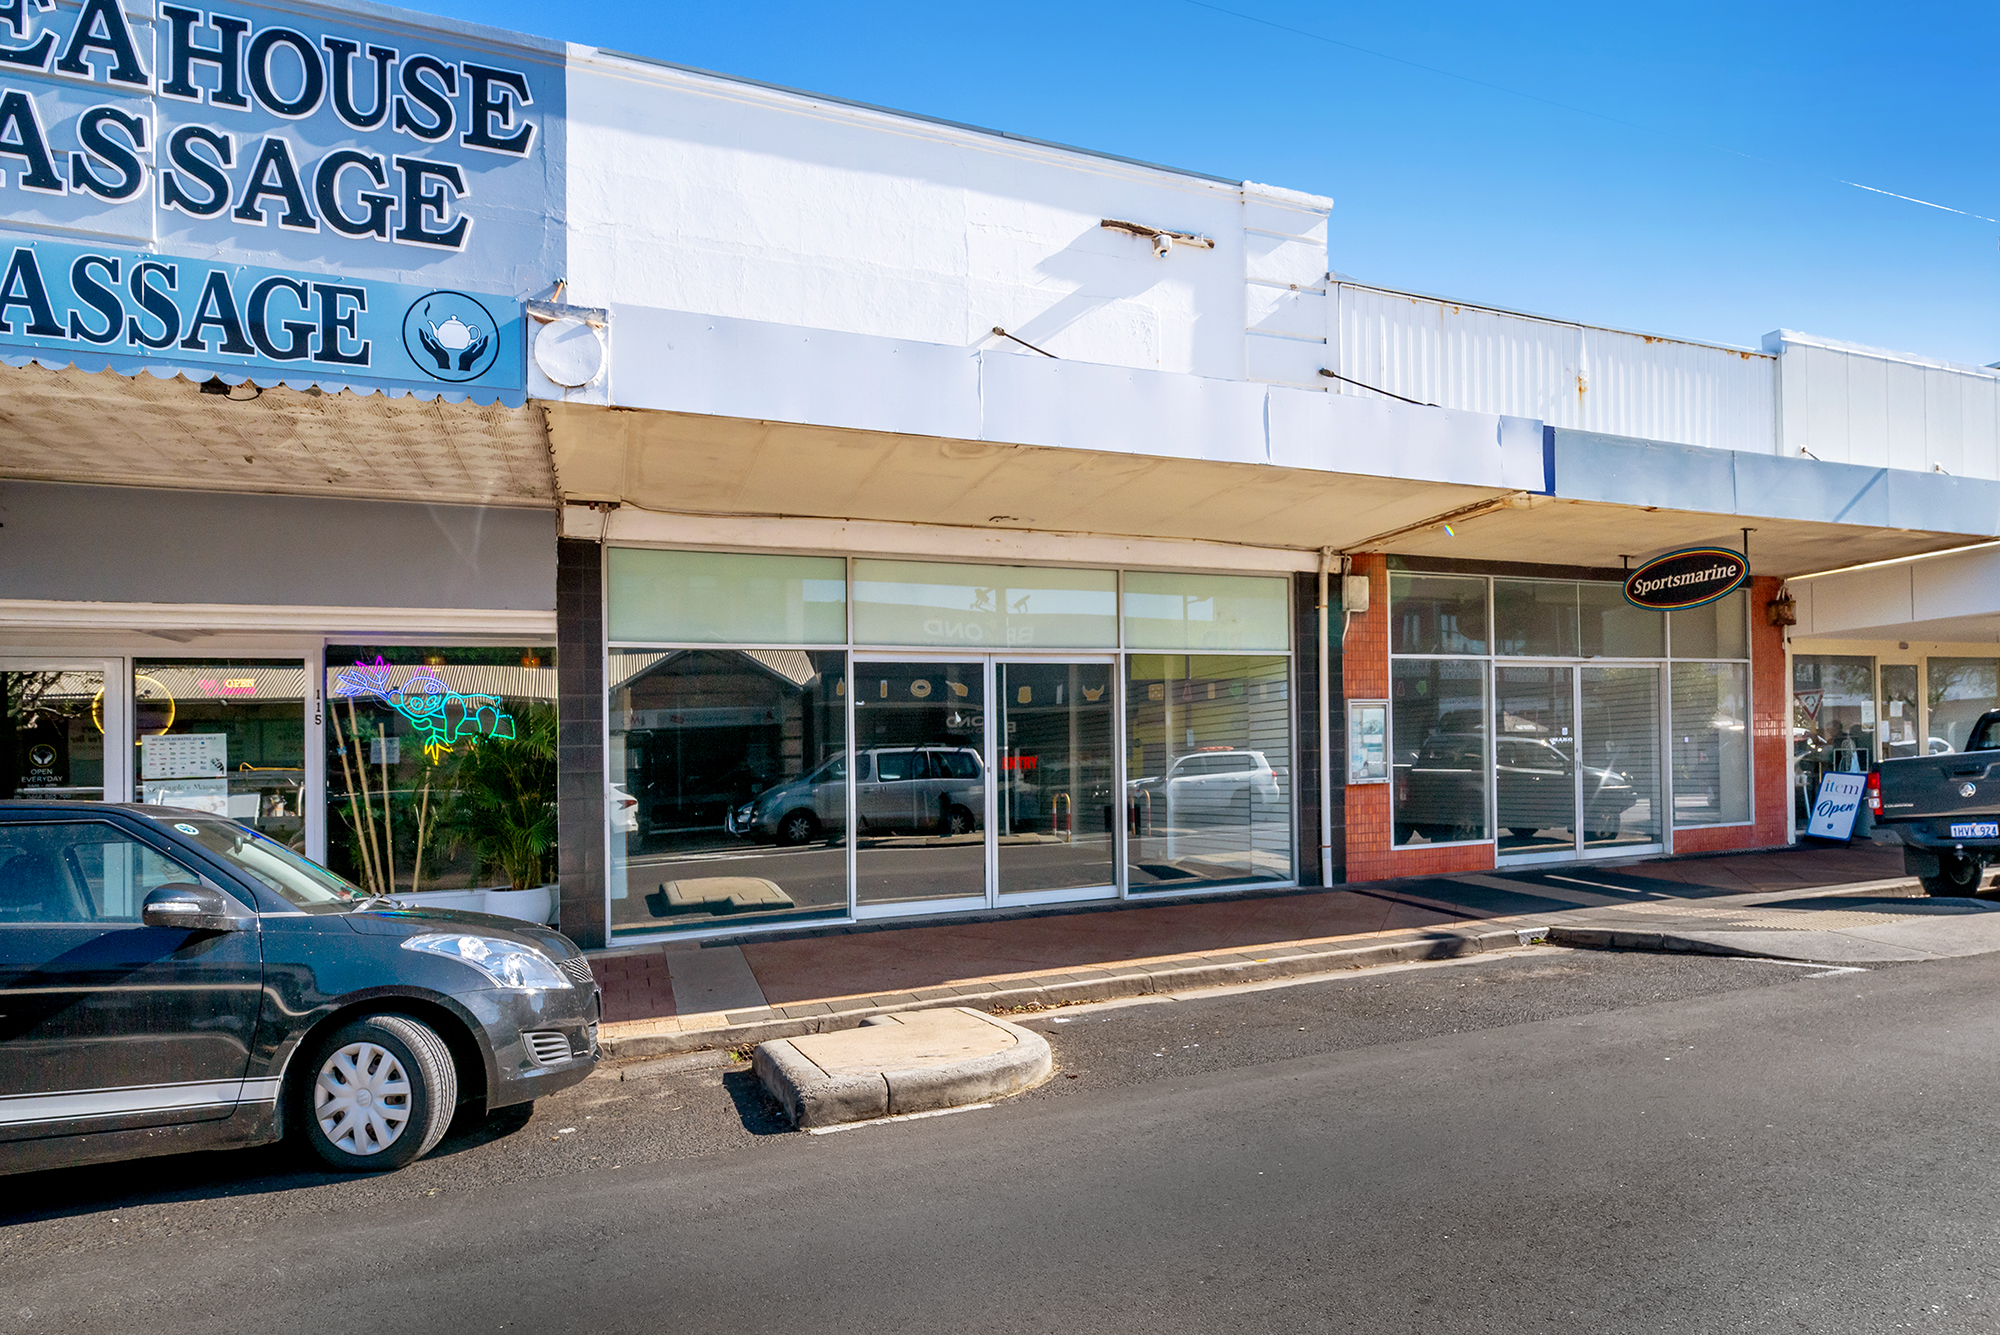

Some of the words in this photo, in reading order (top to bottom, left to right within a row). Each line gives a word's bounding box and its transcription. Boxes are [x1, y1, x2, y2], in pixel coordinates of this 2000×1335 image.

[0, 246, 372, 368] ASSAGE
[1633, 563, 1737, 597] Sportsmarine
[225, 678, 256, 688] OPEN
[314, 689, 322, 726] 115
[1002, 756, 1038, 770] ENTRY
[21, 775, 63, 783] EVERYDAY
[1825, 780, 1859, 795] item
[1817, 799, 1856, 818] Open
[1953, 826, 1977, 837] 1HVK
[1980, 826, 1997, 837] 924
